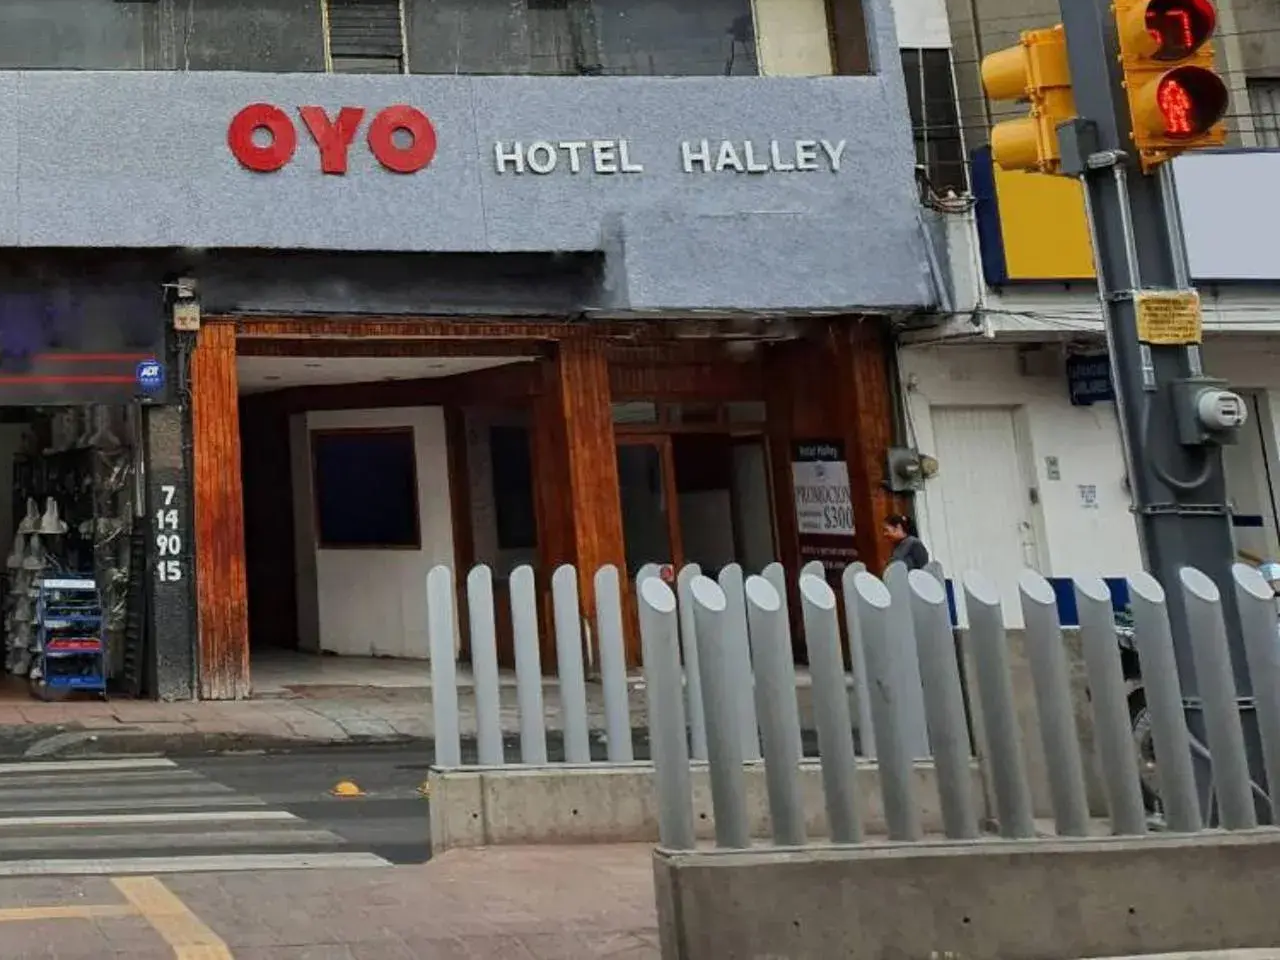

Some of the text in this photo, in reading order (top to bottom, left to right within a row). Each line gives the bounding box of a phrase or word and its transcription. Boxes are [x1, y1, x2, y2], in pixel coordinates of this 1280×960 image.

[227, 102, 437, 174] OYO
[494, 139, 847, 174] HOTEL HALLEY
[161, 485, 175, 505] 7
[156, 509, 178, 529] 14
[156, 534, 181, 556] 90
[157, 560, 181, 582] 15
